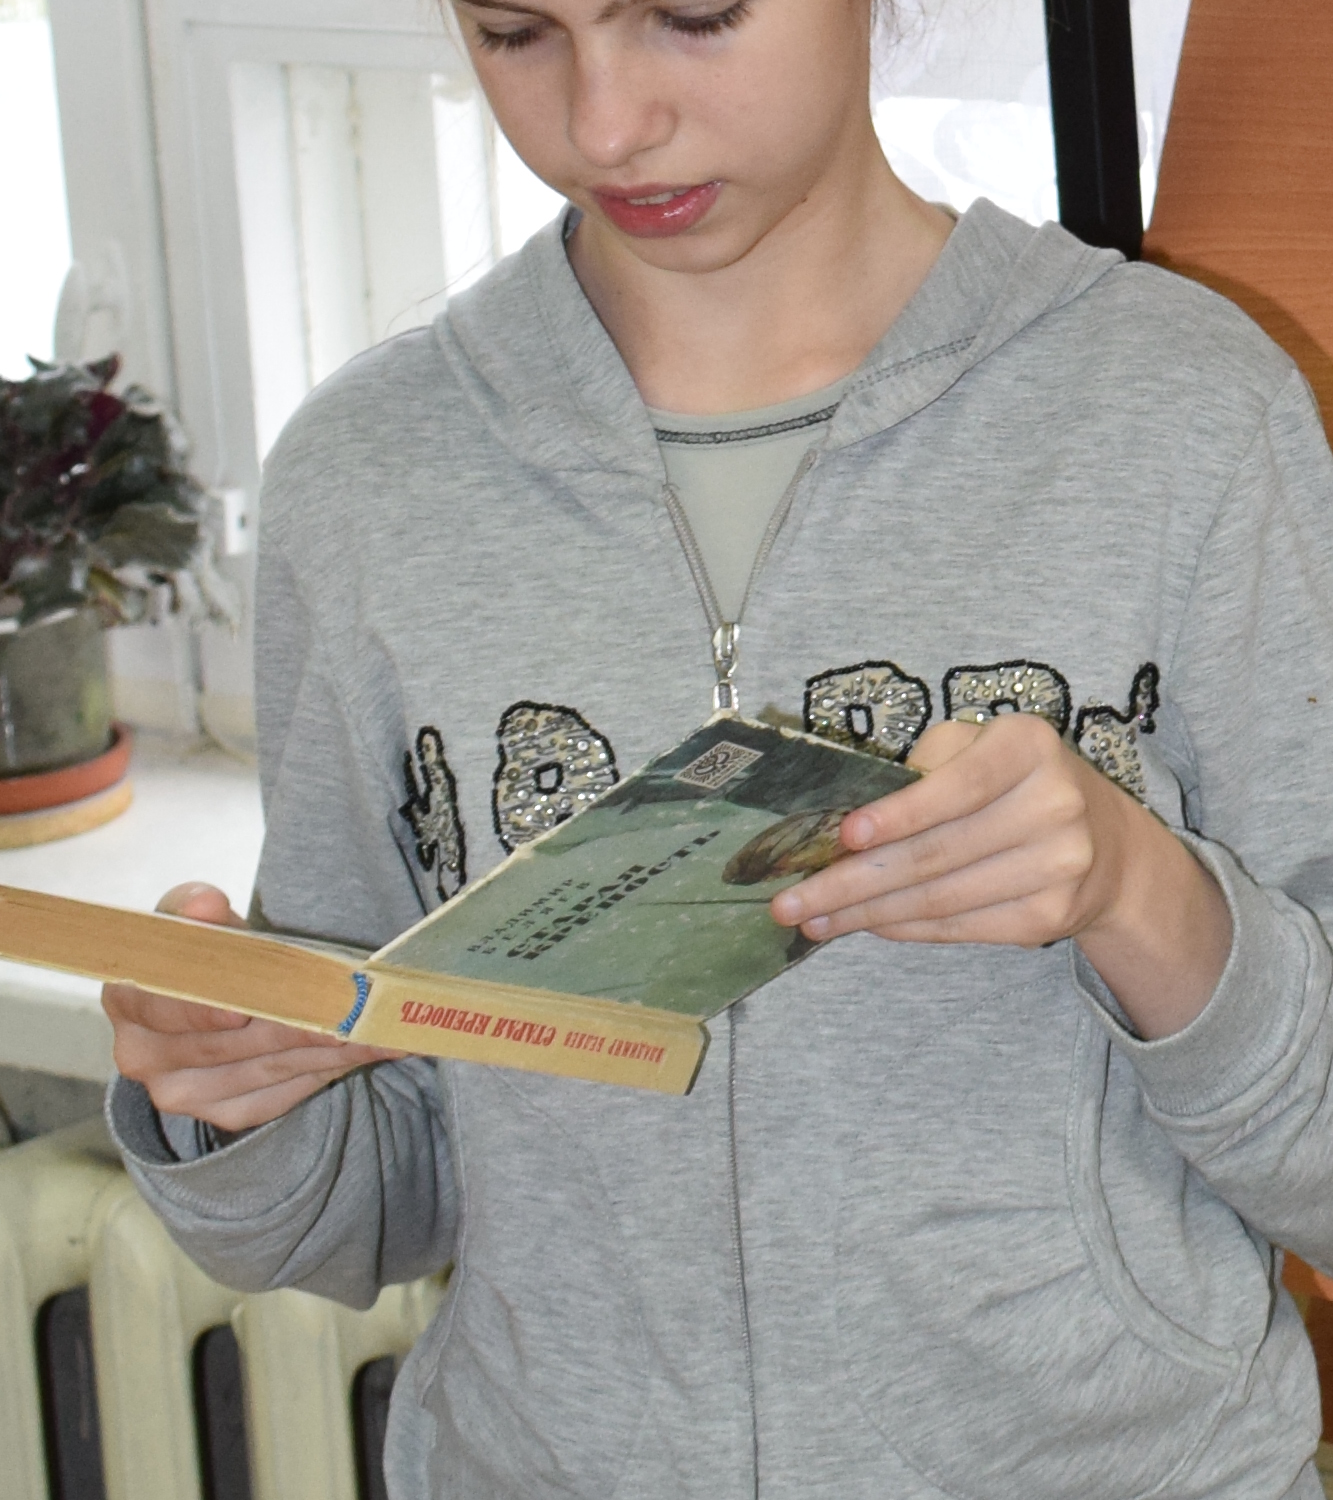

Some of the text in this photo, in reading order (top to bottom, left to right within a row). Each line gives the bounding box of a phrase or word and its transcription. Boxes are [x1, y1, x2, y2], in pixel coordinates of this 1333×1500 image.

[467, 879, 573, 952] ВЛАДИМИР
[506, 864, 646, 957] СТАРАЯ
[522, 830, 721, 960] КРЕПОСТЬ
[400, 1000, 492, 1036] КРЕПОСТЬ
[490, 1016, 557, 1047] СТАРАЯ
[563, 1030, 606, 1053] БЕЛЯЕВ
